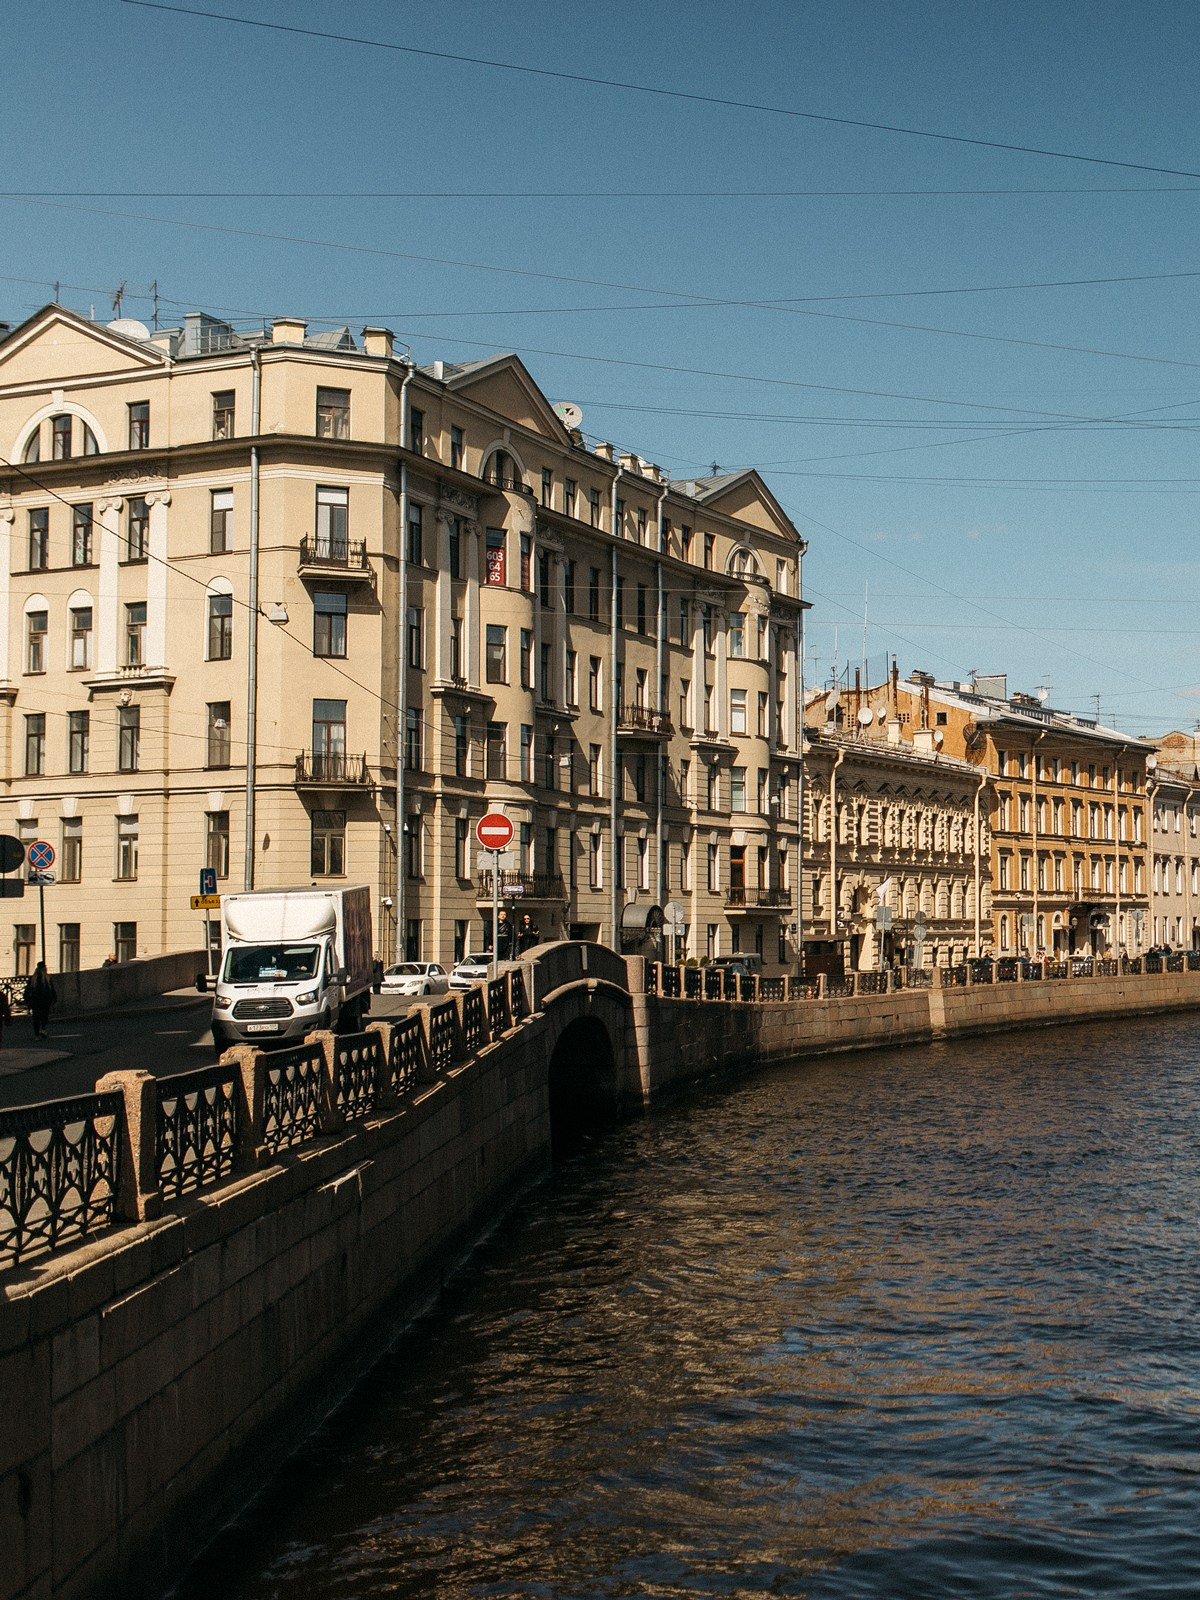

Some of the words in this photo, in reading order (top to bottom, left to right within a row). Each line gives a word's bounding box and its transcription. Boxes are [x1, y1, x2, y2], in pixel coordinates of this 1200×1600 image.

[486, 551, 504, 561] 603
[488, 561, 501, 571] 64
[489, 571, 501, 582] 65
